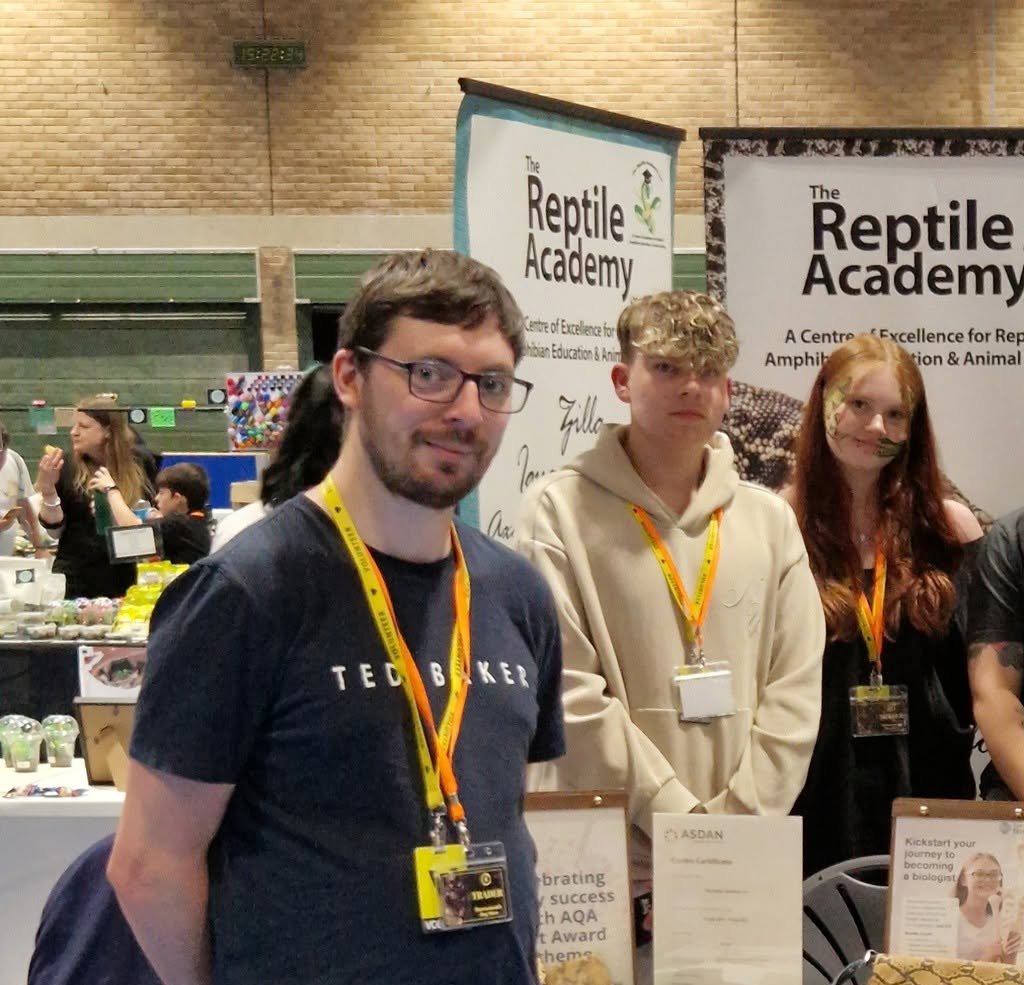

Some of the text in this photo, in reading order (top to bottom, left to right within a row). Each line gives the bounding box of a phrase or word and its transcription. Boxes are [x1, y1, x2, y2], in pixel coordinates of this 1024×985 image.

[525, 155, 540, 173] The
[809, 185, 840, 200] The
[528, 174, 624, 249] Reptile
[812, 199, 1014, 263] Reptile
[525, 233, 633, 302] Academy
[551, 318, 559, 334] of
[561, 319, 602, 337] Excellence
[784, 330, 796, 343] A
[801, 329, 855, 344] Centre
[968, 328, 991, 343] for
[526, 342, 550, 358] hibian
[552, 344, 593, 360] Education
[602, 347, 620, 361] Anim
[765, 352, 832, 370] Amphib
[948, 352, 960, 366] &
[964, 351, 1021, 366] Animal
[331, 661, 529, 691] TED BKER
[681, 830, 723, 840] ASDAN
[905, 838, 976, 849] Kickstart your
[904, 851, 942, 860] journey
[904, 861, 953, 871] becoming
[540, 871, 606, 888] brating
[912, 873, 956, 883] biologist
[550, 892, 615, 905] success
[561, 909, 598, 925] AQA
[552, 927, 606, 944] Award
